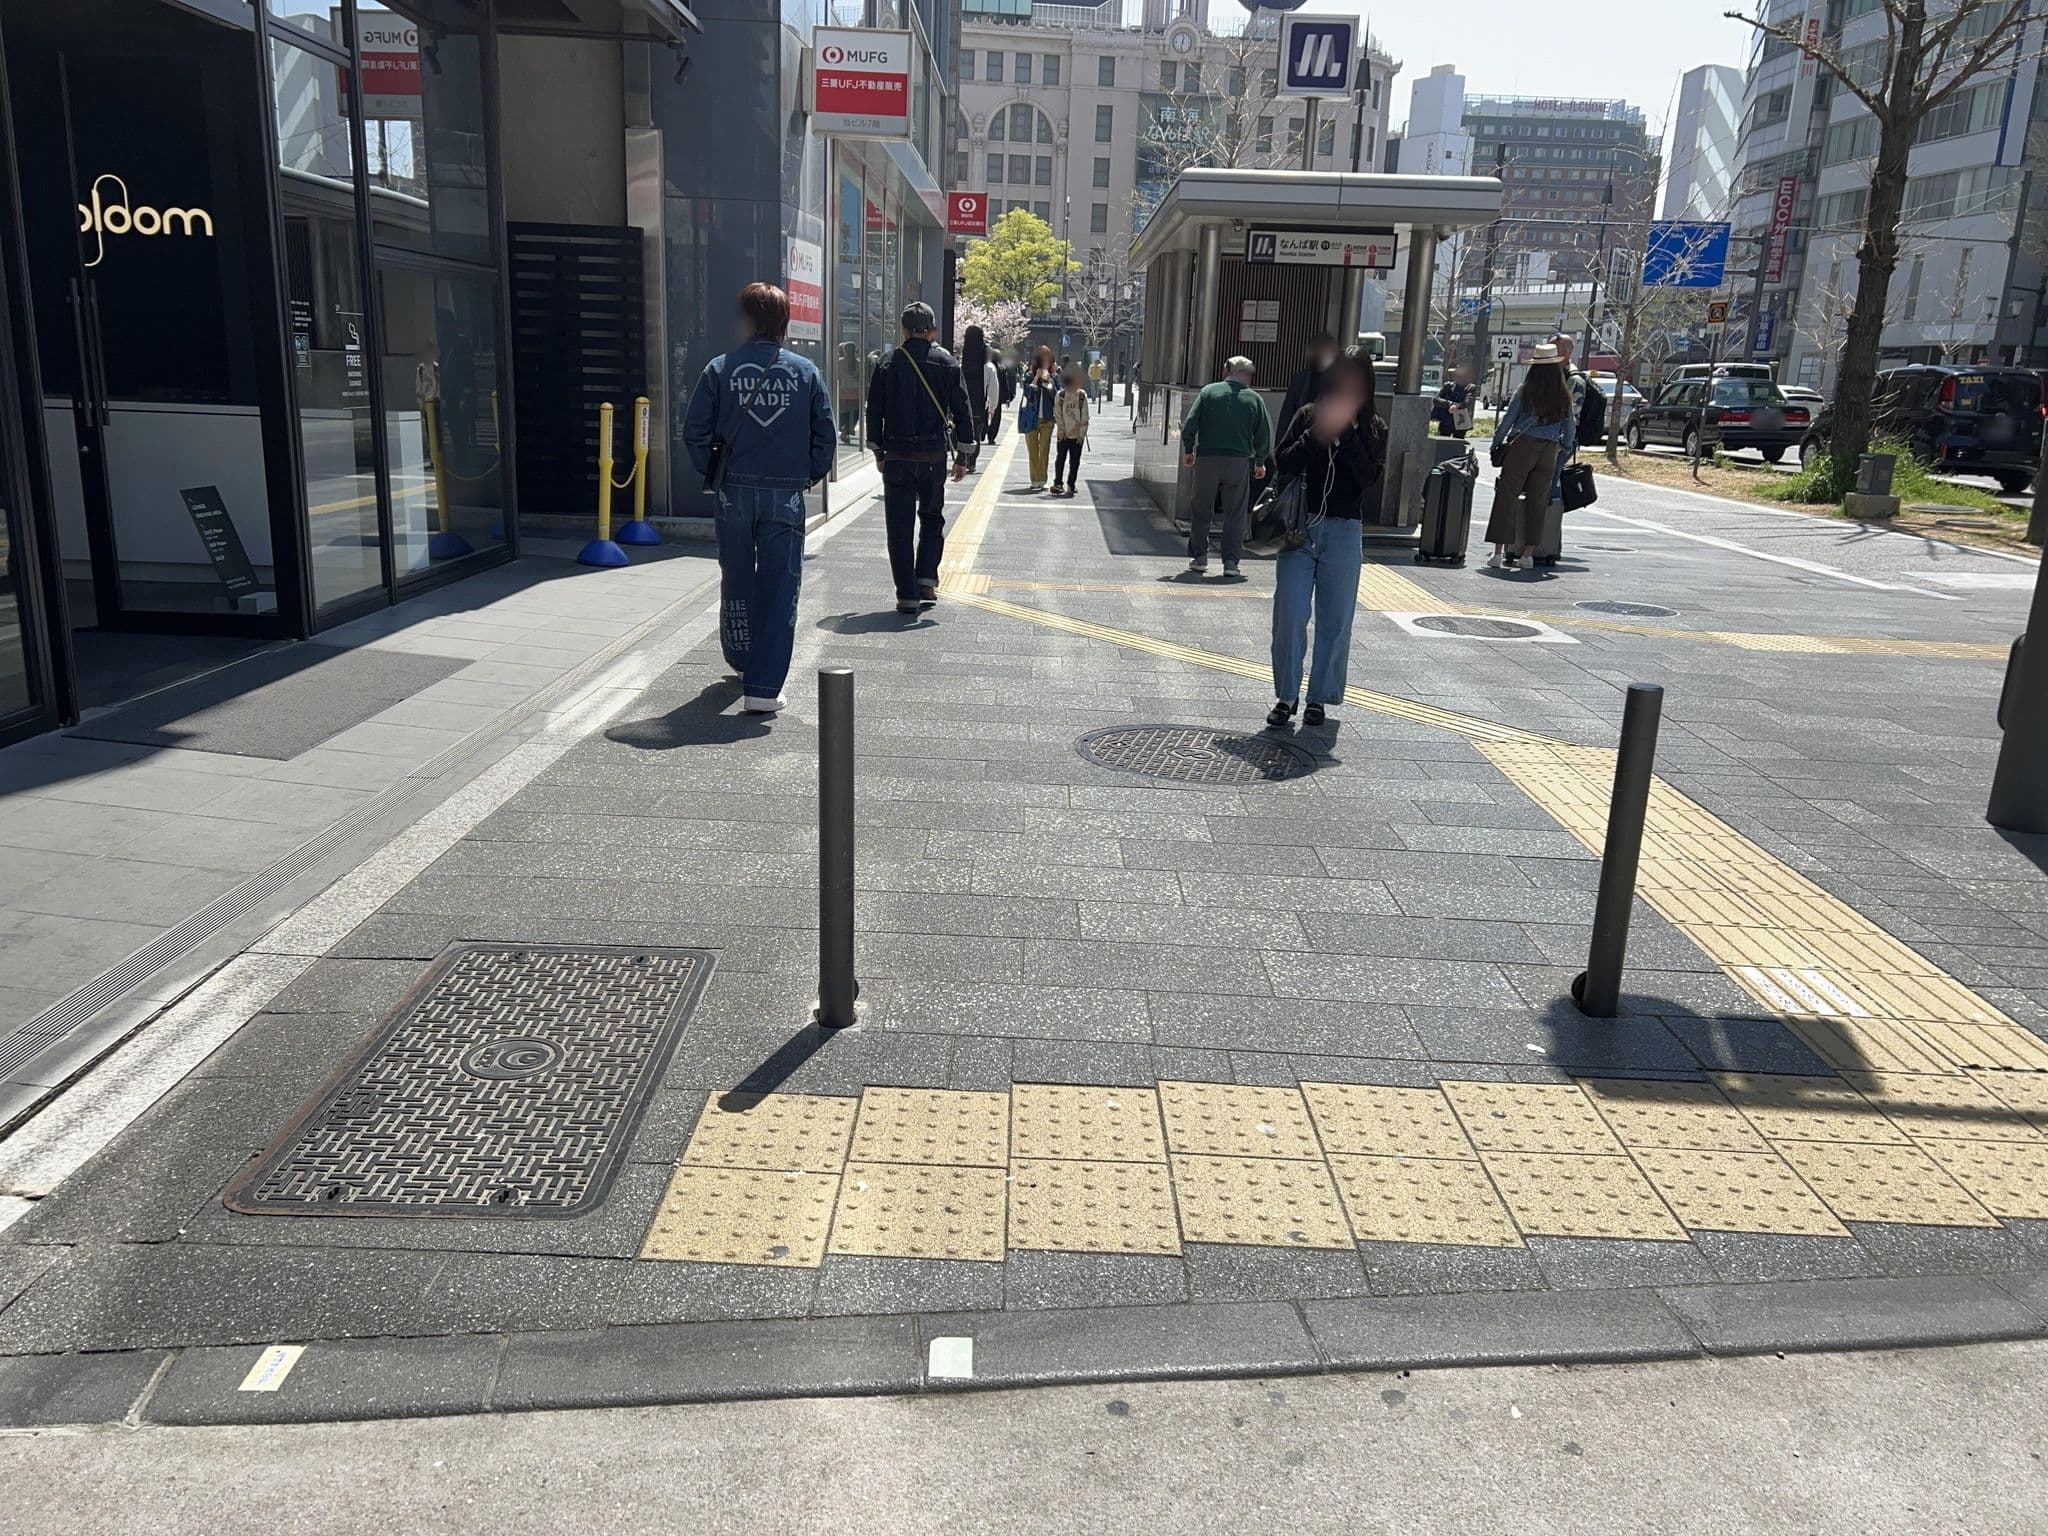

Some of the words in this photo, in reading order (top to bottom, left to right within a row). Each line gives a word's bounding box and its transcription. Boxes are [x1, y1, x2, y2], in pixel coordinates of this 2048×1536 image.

[847, 50, 888, 64] MUFG
[821, 78, 902, 91] 三菱UFJ不動産販売
[1533, 99, 1564, 111] HOTEL
[1279, 239, 1319, 250] なんば駅
[346, 355, 361, 366] FREE
[729, 377, 799, 392] HUMAN
[1959, 376, 1984, 384] TAXI
[739, 393, 791, 406] MADE
